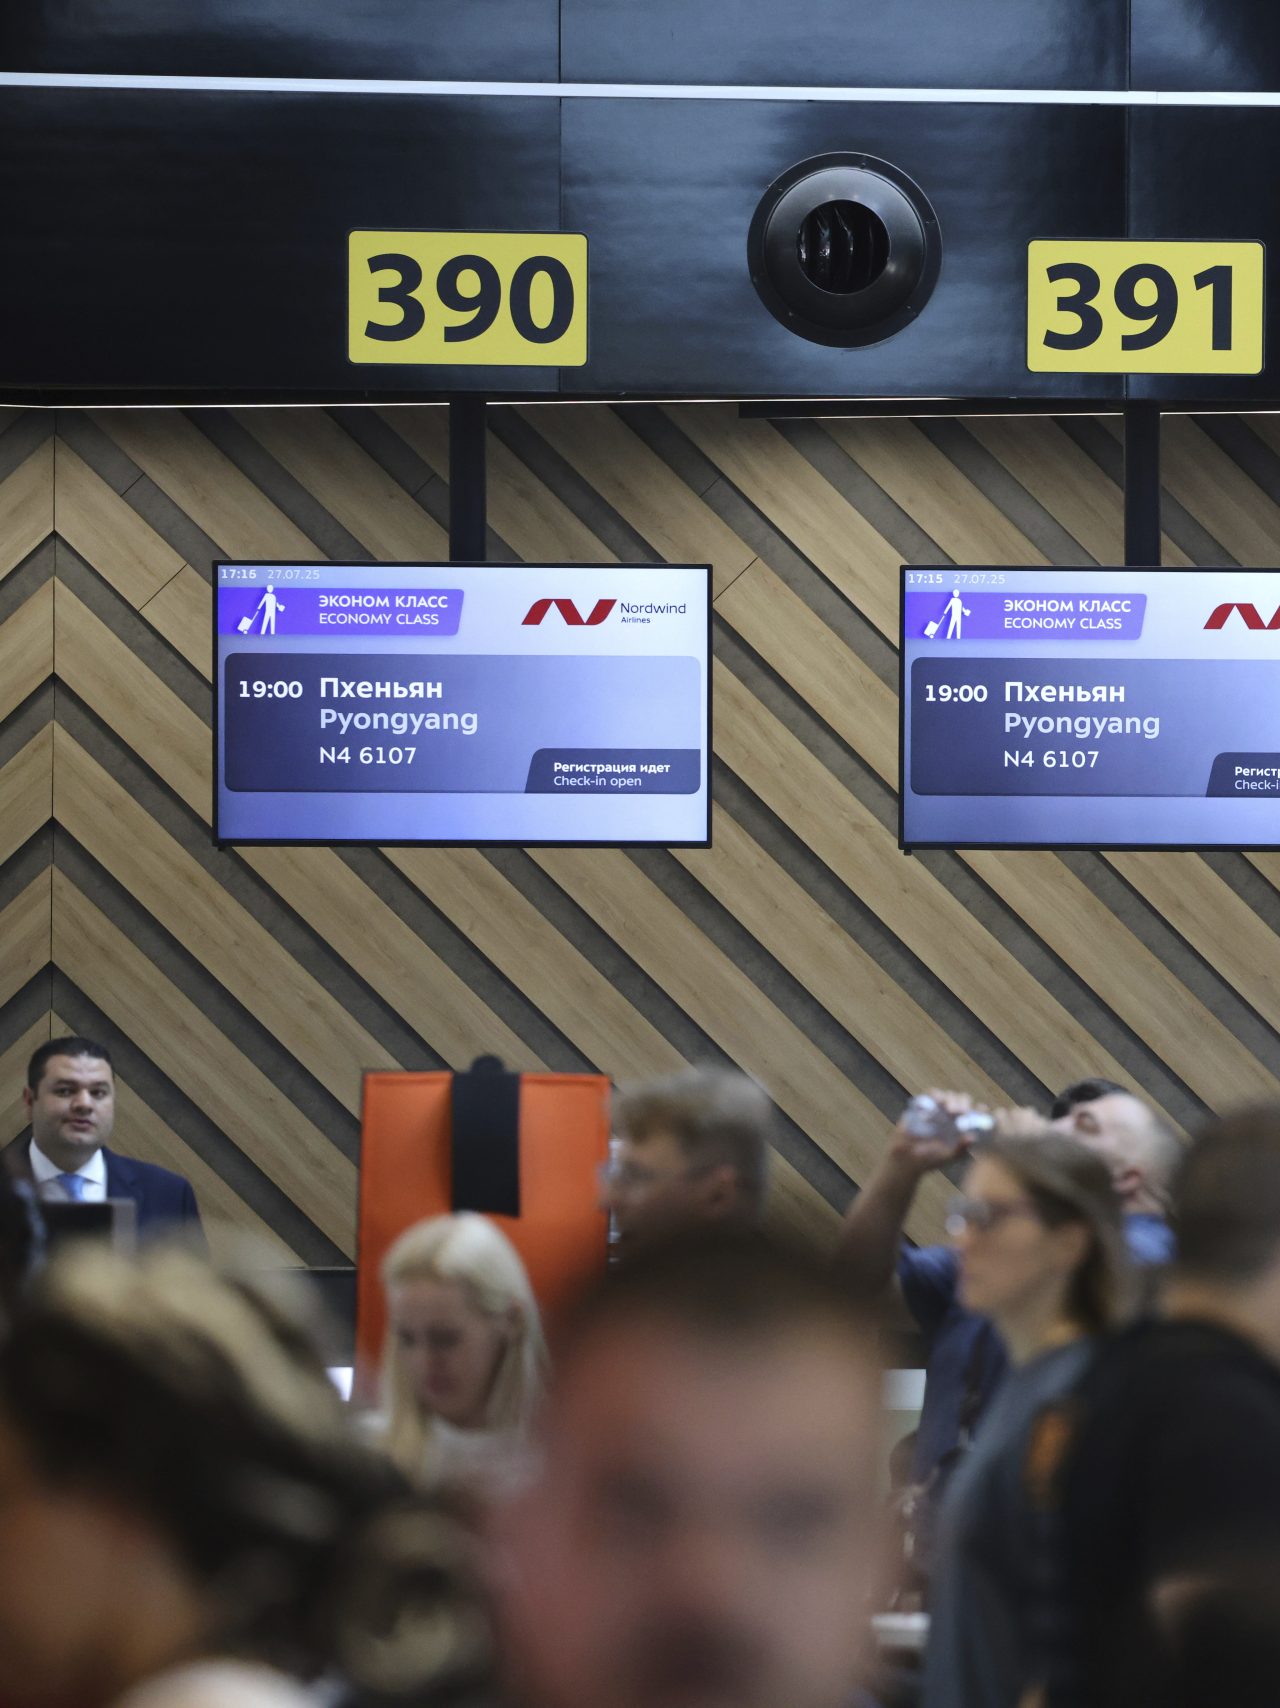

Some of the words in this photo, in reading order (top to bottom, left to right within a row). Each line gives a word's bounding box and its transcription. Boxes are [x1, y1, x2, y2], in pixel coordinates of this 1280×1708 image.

[365, 253, 574, 344] 390
[1043, 263, 1232, 351] 391
[267, 568, 321, 580] 27.07.25
[908, 573, 943, 585] 17:15
[952, 573, 1006, 586] 27.07.25
[318, 594, 390, 608] ЭКОНОМ
[395, 595, 449, 609] КЛАСС
[620, 602, 687, 614] Nordwind
[1003, 599, 1074, 613] ЭКОНОМ
[1079, 599, 1132, 613] КЛАСС
[319, 612, 393, 625] ECONOMY
[395, 613, 440, 626] CLASS
[620, 616, 651, 624] Airlines
[1004, 617, 1077, 629] ECONOMY
[1079, 617, 1123, 630] CLASS
[239, 680, 304, 699] 19:00
[320, 677, 443, 699] Пхеньян
[925, 684, 988, 703] 19:00
[1005, 681, 1125, 703] Пхеньян
[320, 708, 479, 736] Pyongyang
[1005, 712, 1160, 740] Pyongyang
[319, 746, 352, 764] N4
[359, 746, 417, 765] 6107
[1004, 750, 1035, 768] N4
[1042, 750, 1100, 769] 6107
[553, 762, 637, 775] Регистрация
[639, 764, 671, 774] идет
[553, 775, 607, 786] Check-in
[609, 777, 642, 789] open
